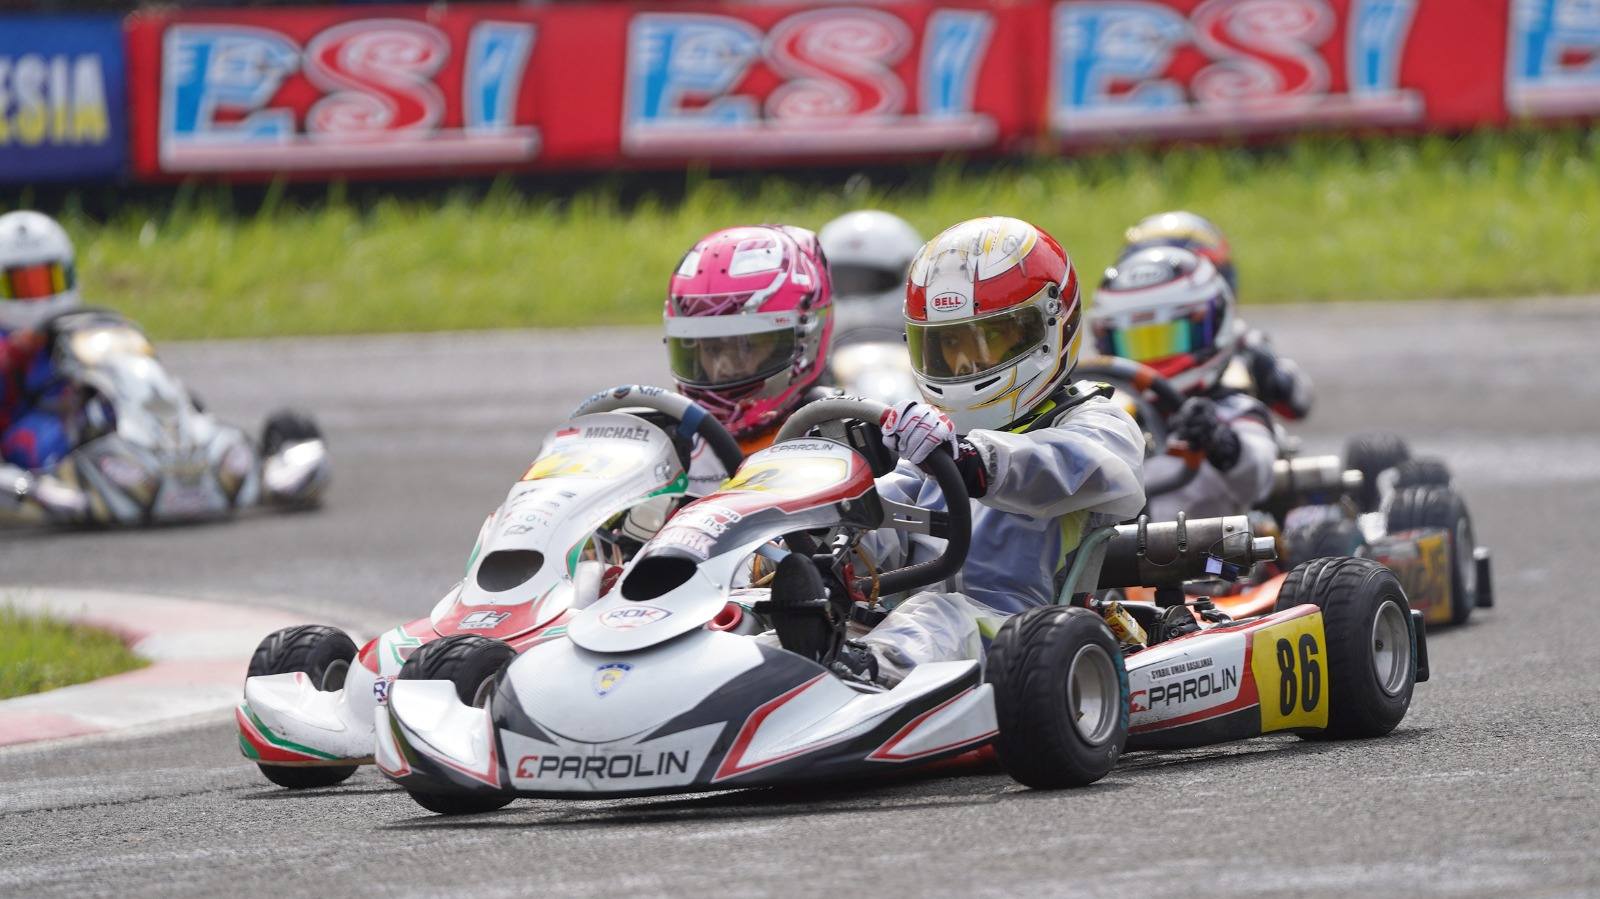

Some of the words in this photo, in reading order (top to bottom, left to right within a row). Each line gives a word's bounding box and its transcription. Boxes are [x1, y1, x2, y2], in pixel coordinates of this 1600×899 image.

[934, 296, 961, 307] BELL
[585, 426, 650, 442] MICHAEL
[1276, 633, 1321, 717] 86
